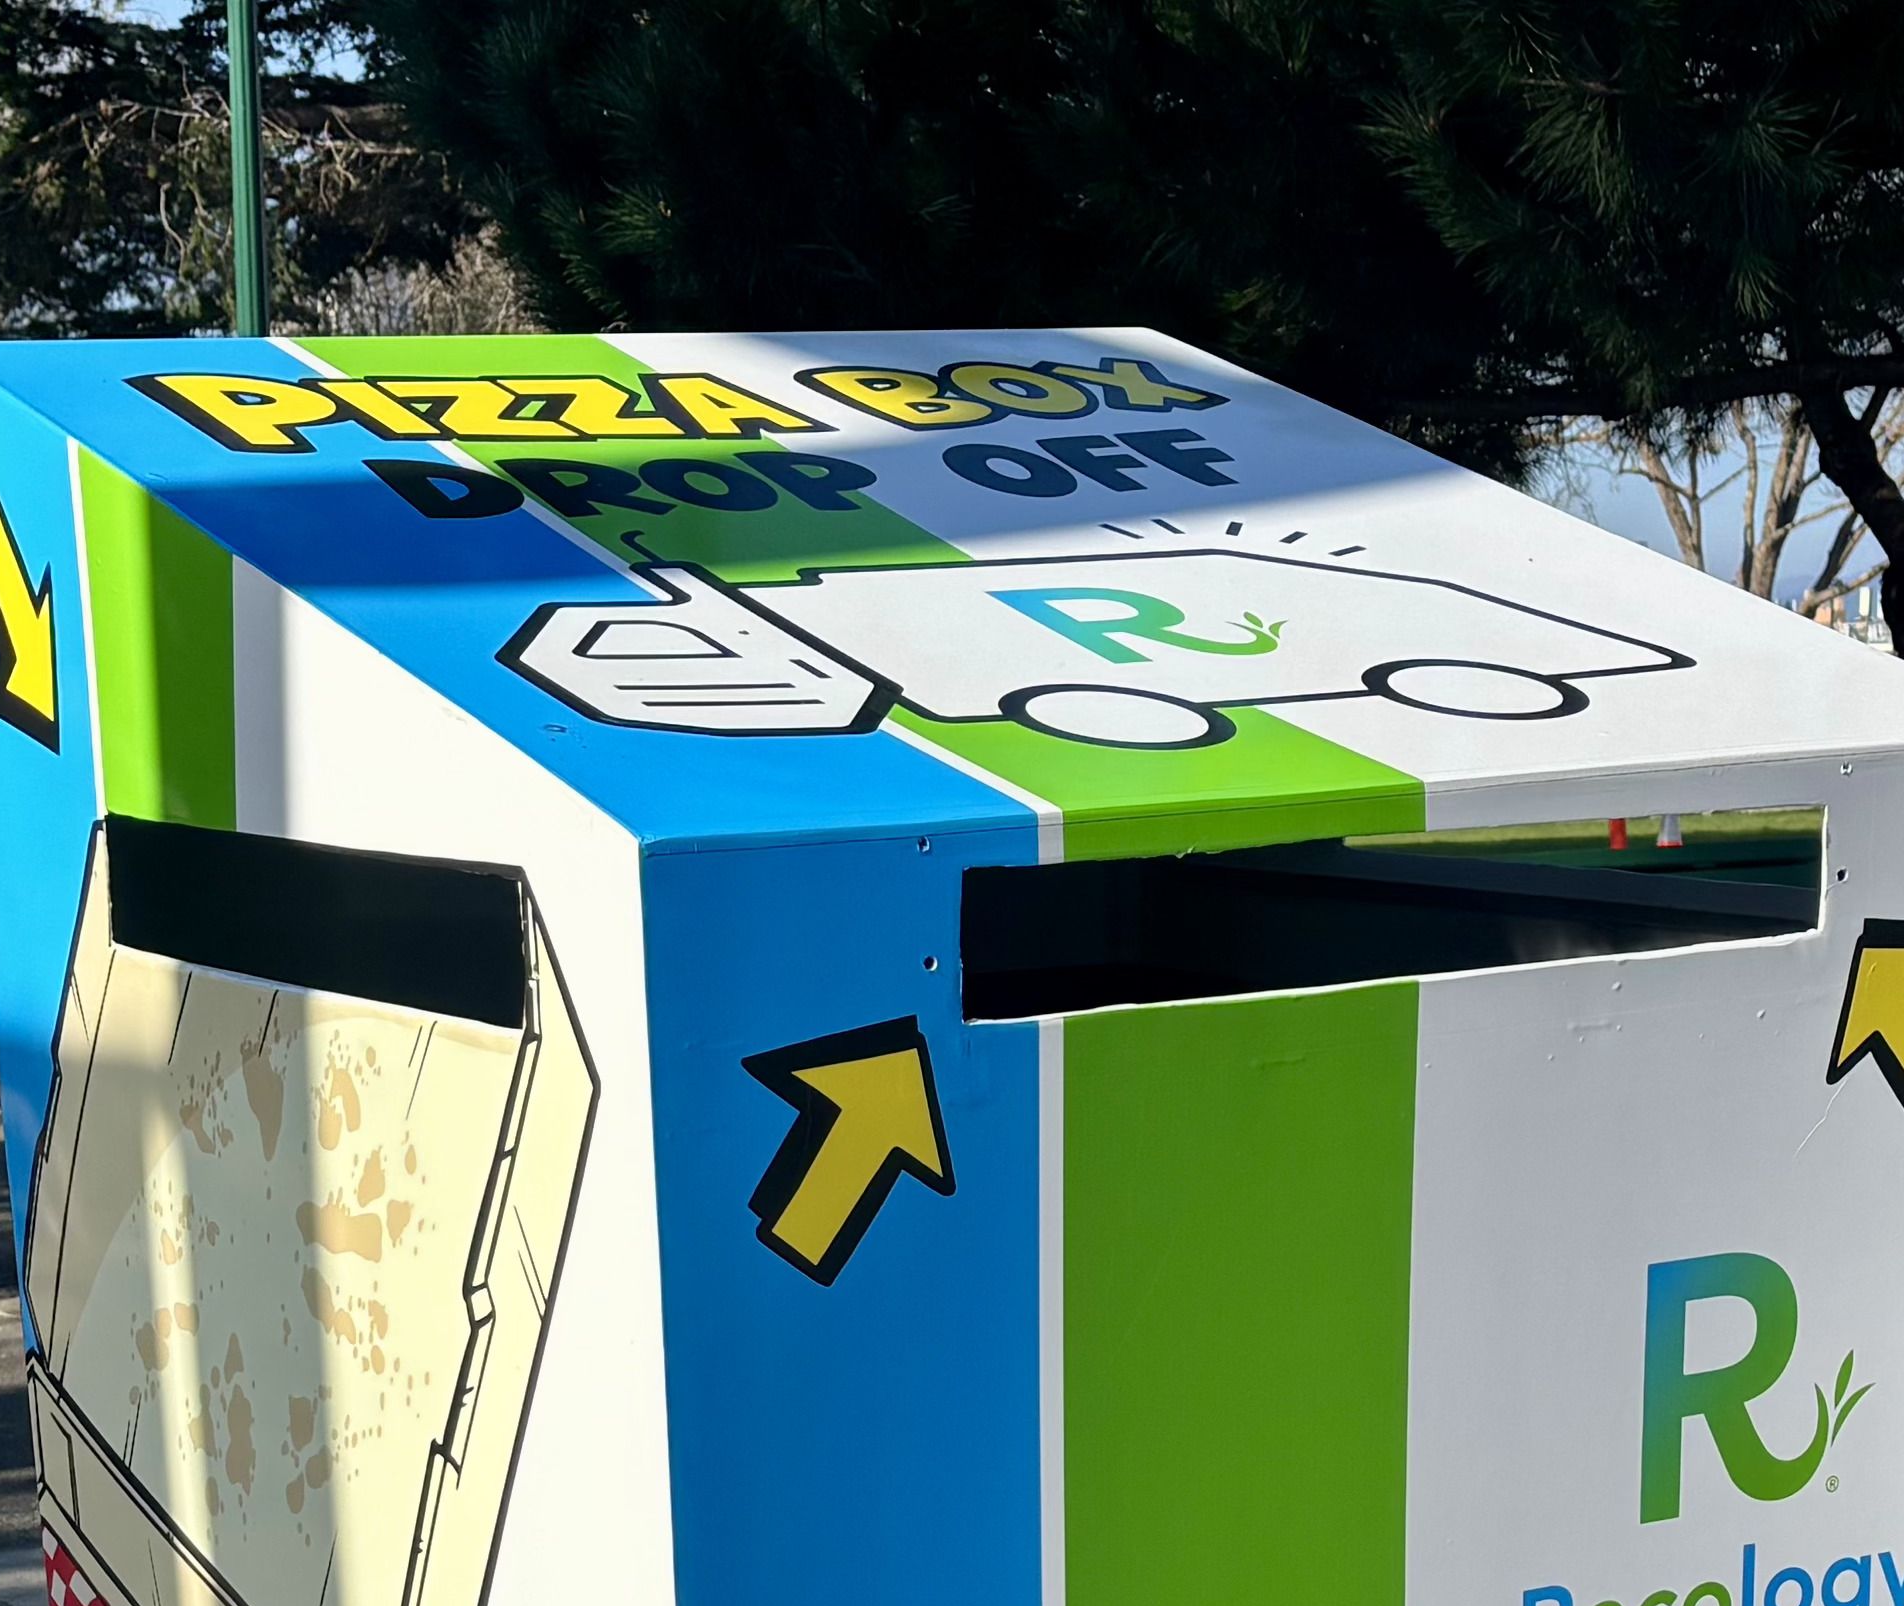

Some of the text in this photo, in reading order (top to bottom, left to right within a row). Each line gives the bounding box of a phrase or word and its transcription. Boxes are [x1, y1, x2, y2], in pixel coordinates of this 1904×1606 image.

[124, 357, 1231, 453] PIZZA BOX
[362, 428, 1239, 518] DROP OFF
